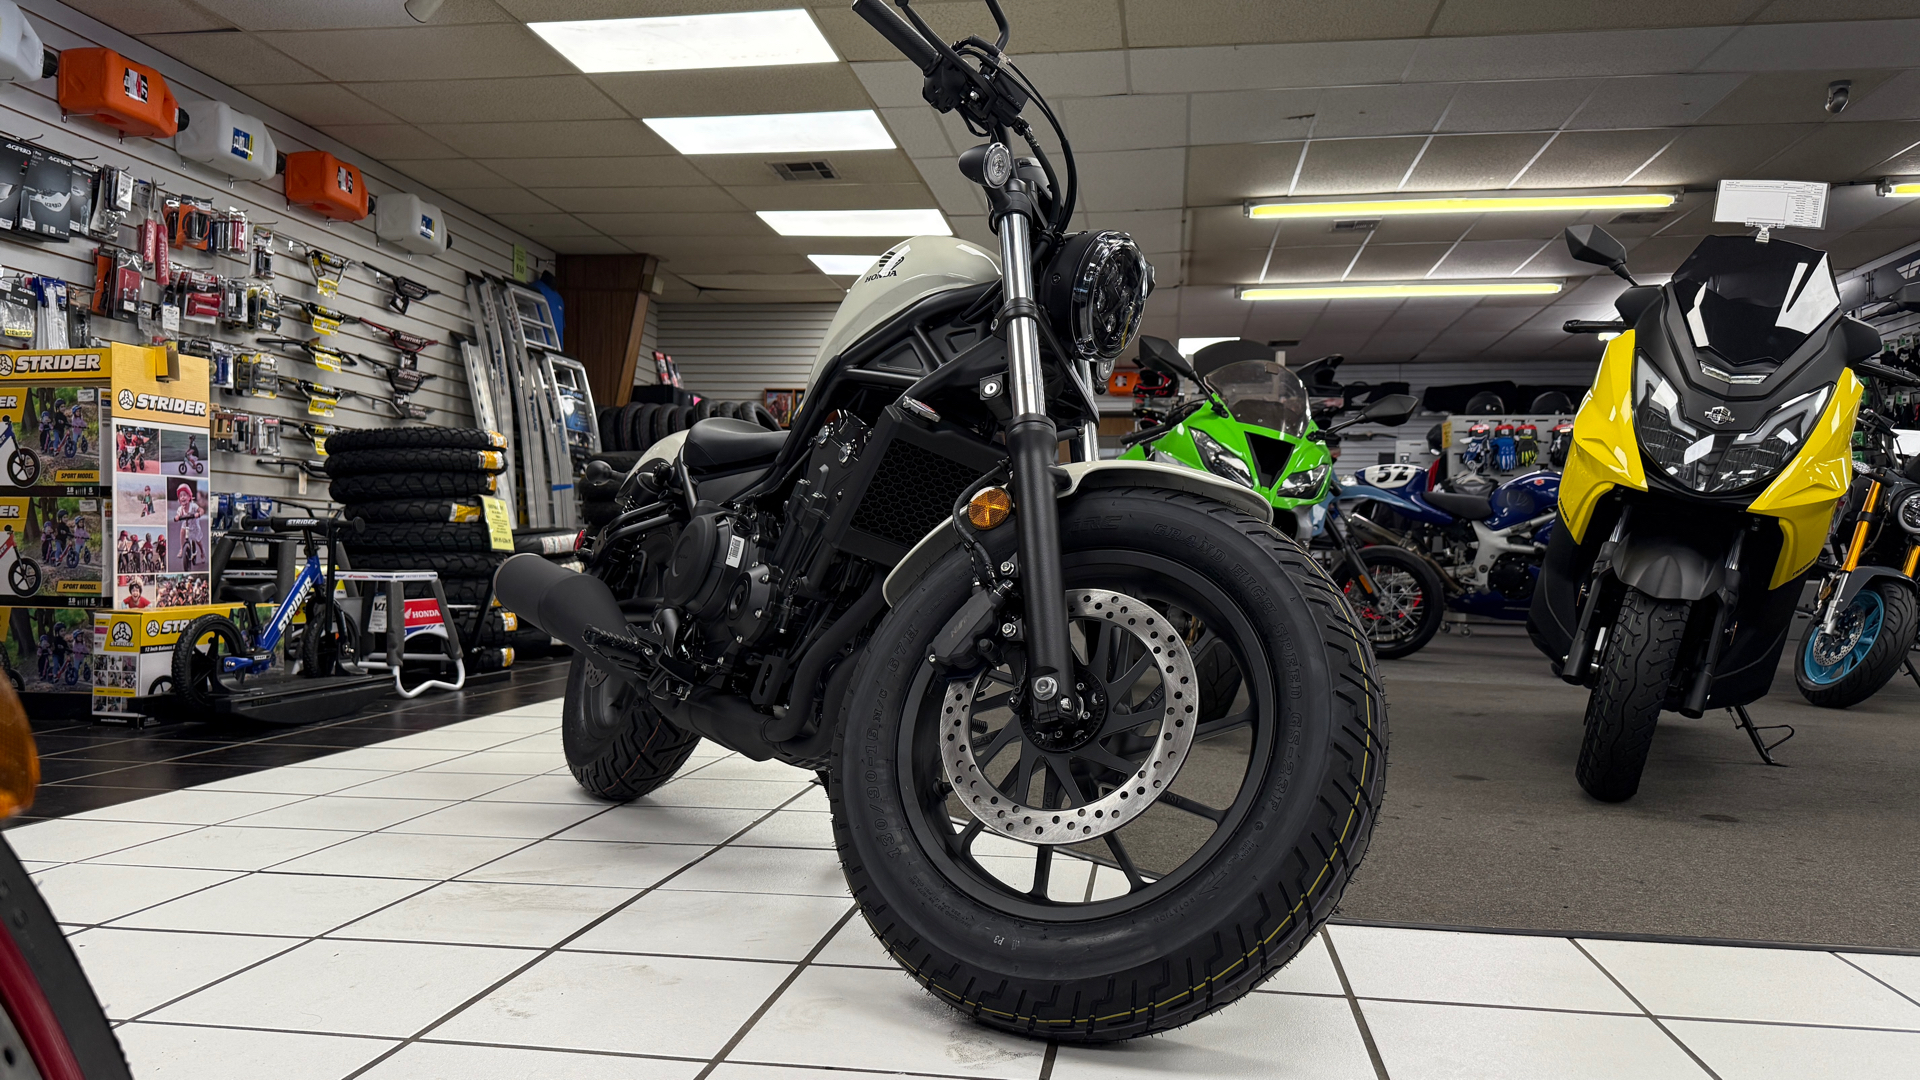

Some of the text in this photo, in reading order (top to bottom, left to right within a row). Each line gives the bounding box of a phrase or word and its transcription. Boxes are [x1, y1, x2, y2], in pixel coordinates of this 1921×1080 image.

[159, 243, 168, 278] HONDA
[16, 354, 100, 372] STRIDER
[135, 393, 207, 417] STRIDER
[1376, 466, 1409, 483] 52
[277, 575, 314, 635] STRIDER
[412, 609, 440, 619] HONDA
[1151, 523, 1227, 562] GRAND
[1229, 564, 1278, 615] HIGH
[1272, 623, 1303, 700] SPEED
[1153, 897, 1196, 924] ROTATION
